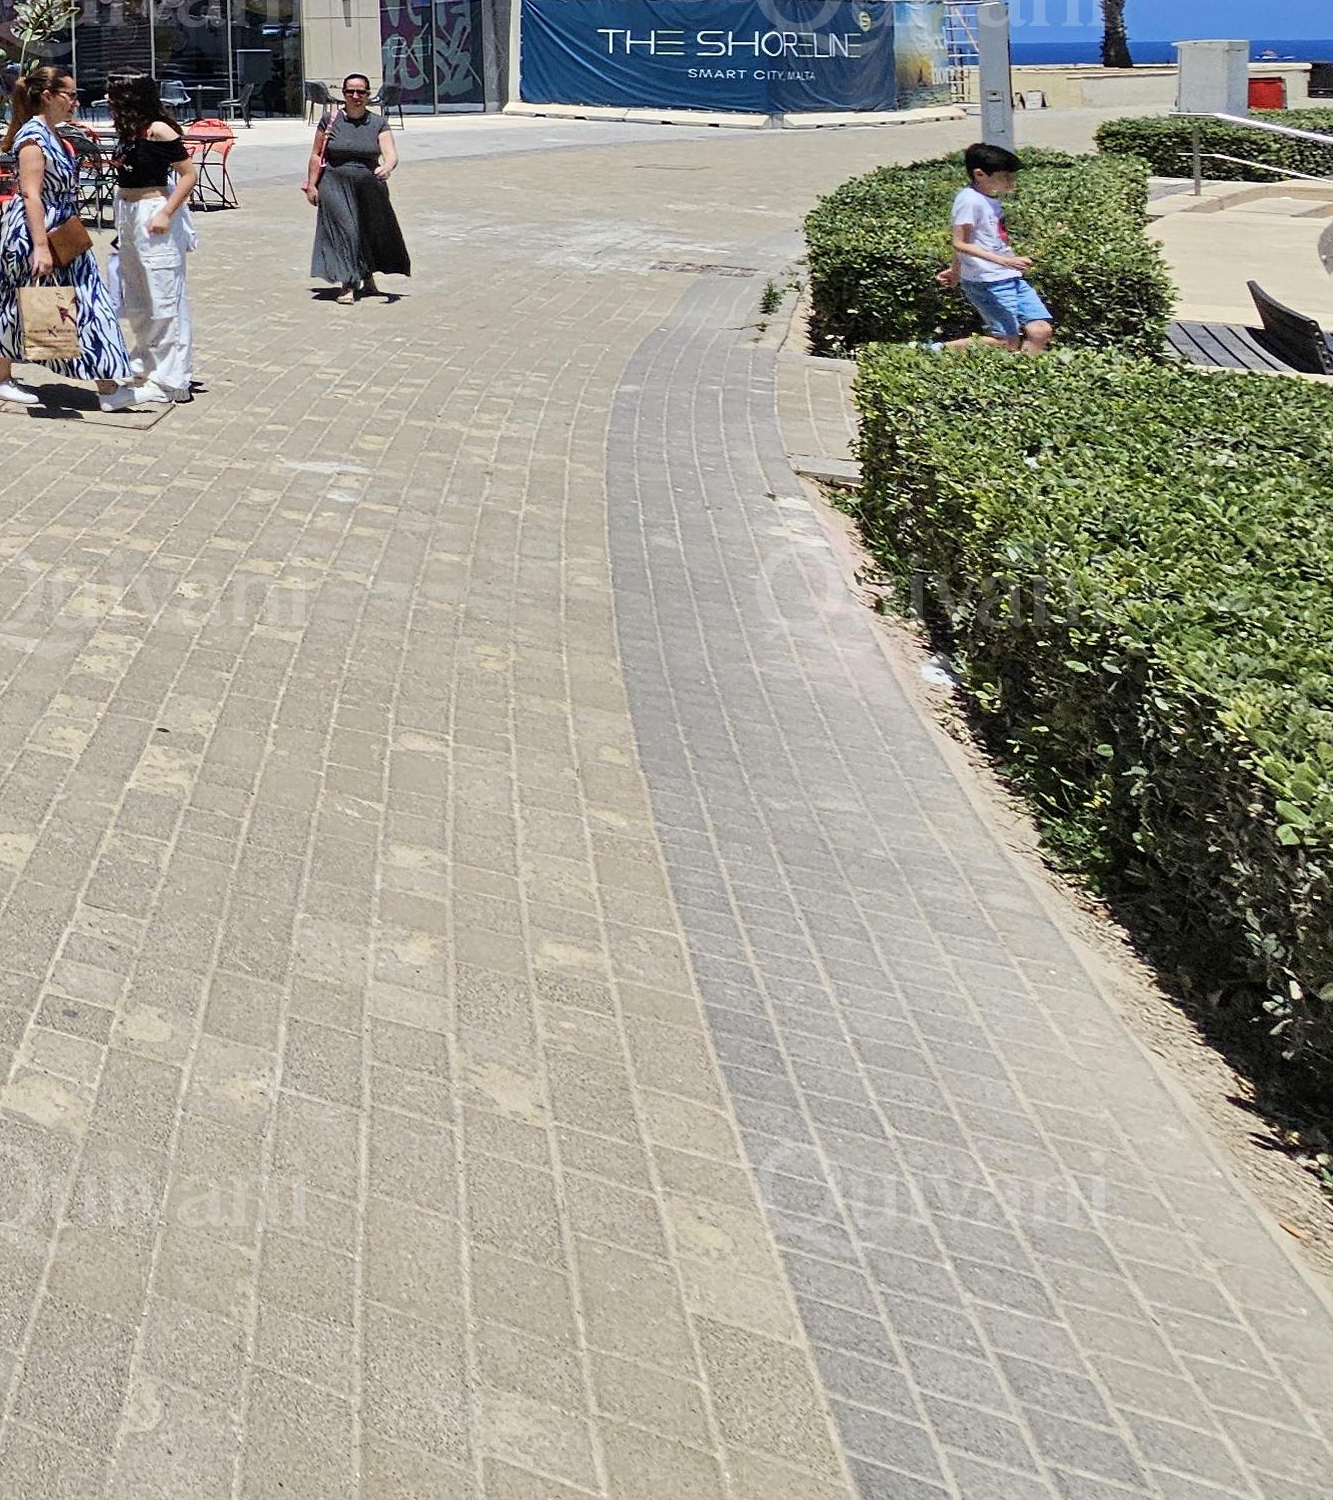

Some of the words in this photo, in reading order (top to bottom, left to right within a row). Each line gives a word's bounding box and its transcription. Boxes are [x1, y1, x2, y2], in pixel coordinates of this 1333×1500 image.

[597, 28, 685, 56] THE
[696, 30, 862, 58] SHORELINE
[687, 67, 747, 80] SMART
[787, 70, 816, 80] MALTA
